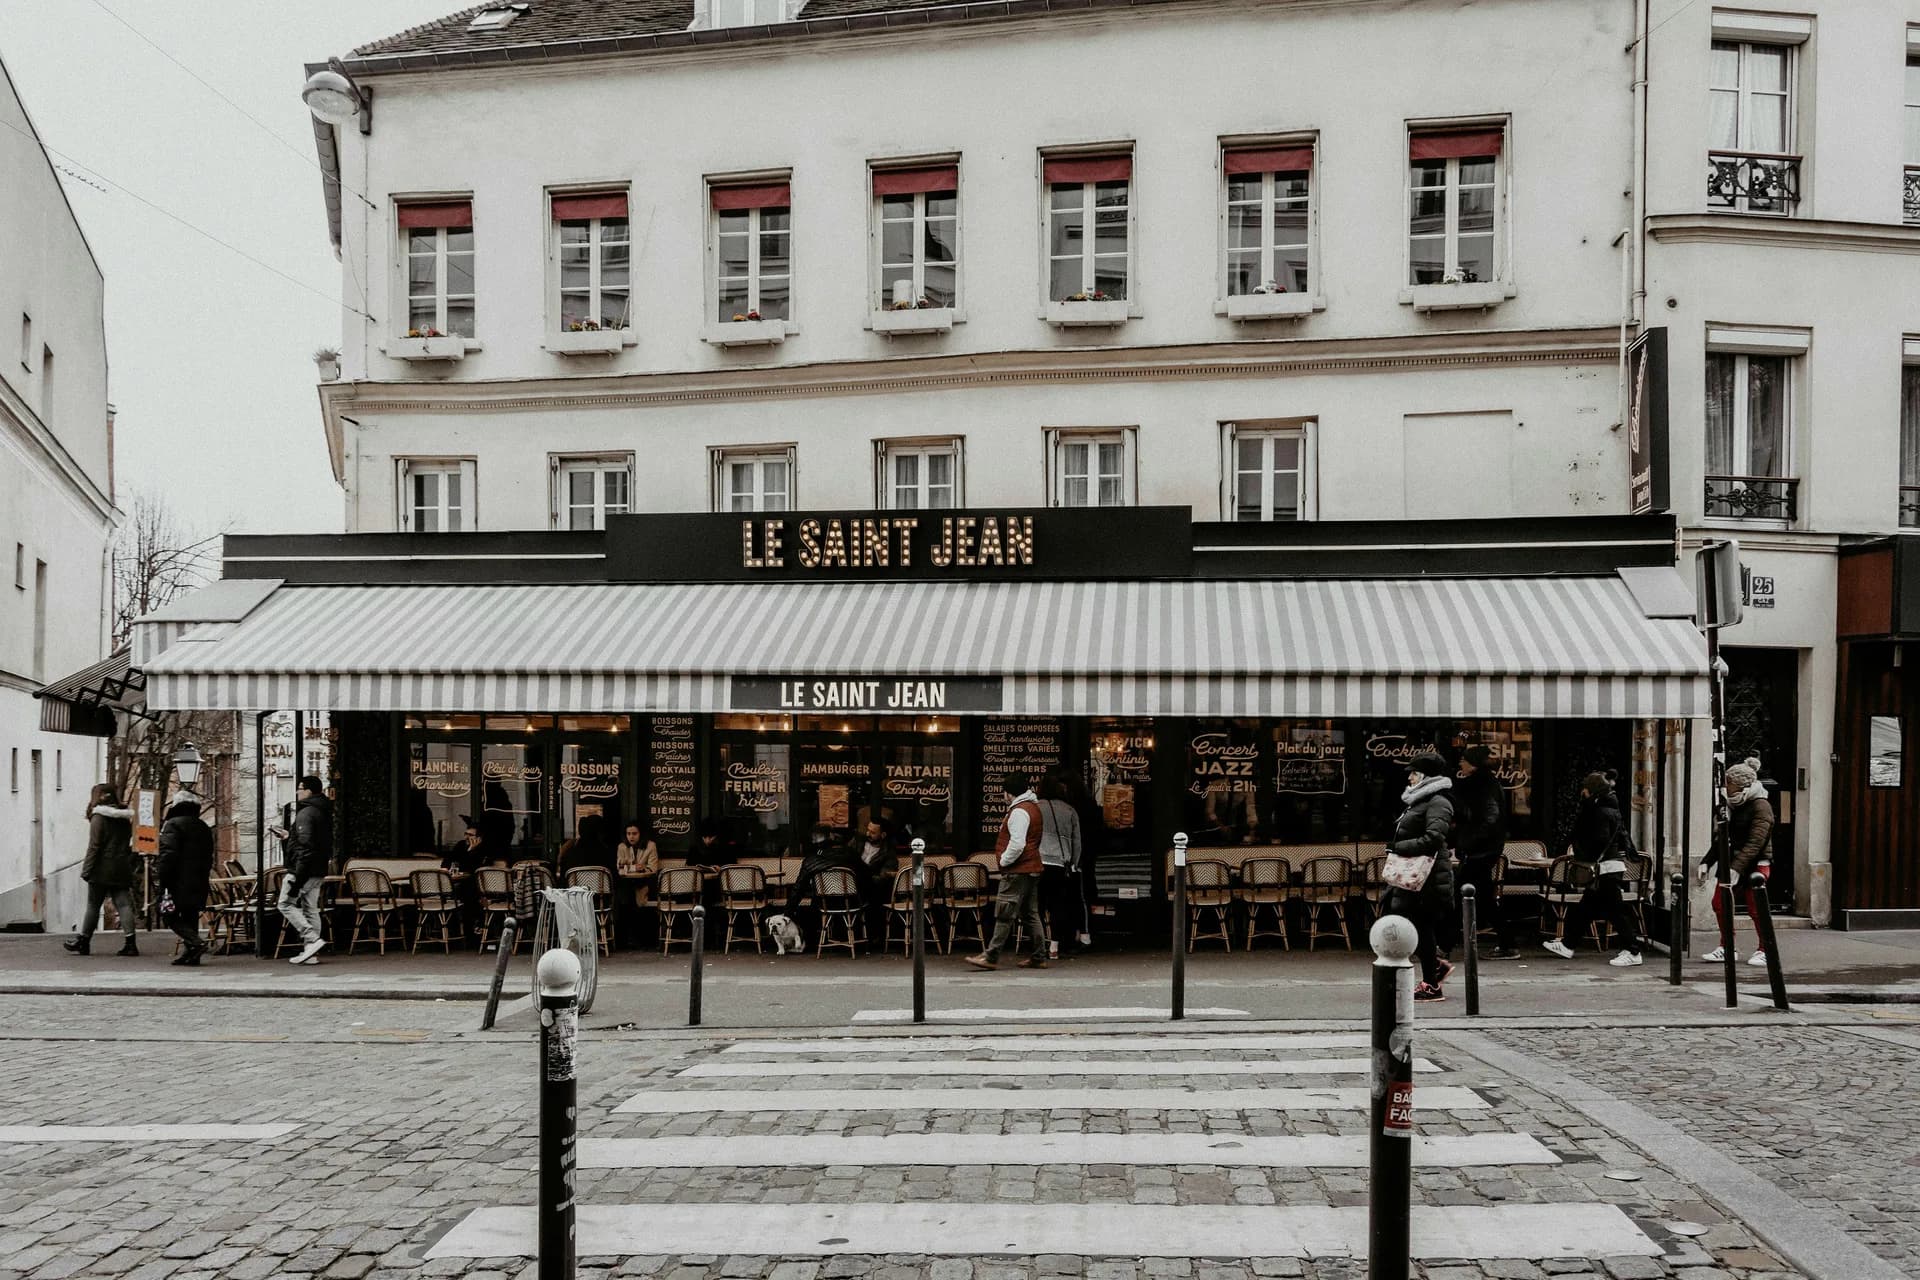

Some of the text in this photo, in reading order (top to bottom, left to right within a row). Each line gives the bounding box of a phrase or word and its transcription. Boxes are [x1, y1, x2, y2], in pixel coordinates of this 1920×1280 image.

[743, 516, 1034, 567] LE SAINT JEAN
[1754, 577, 1773, 594] 25
[781, 681, 946, 708] LE SAINT JEAN
[651, 717, 693, 725] BOISSONS
[983, 724, 1015, 733] SALADES
[651, 741, 695, 750] BOISSONS
[983, 744, 1024, 753] OMELETTES
[1191, 733, 1260, 760] Concert
[1276, 741, 1345, 759] Plat du jour
[1101, 749, 1150, 769] Continu
[412, 761, 460, 774] PLANCHE
[507, 763, 518, 774] du
[518, 763, 543, 780] jour
[560, 763, 620, 775] BOISSONS
[650, 766, 696, 774] COCKTAILS
[727, 762, 782, 781] Poulet
[803, 763, 870, 775] HAMBURGER
[886, 765, 951, 778] TARTARE
[1194, 760, 1254, 776] JAZZ
[413, 774, 472, 798] Charcuterie
[562, 776, 619, 799] Chaudes
[724, 780, 786, 793] FERMIER
[886, 779, 951, 805] Charolais
[1188, 780, 1203, 795] Le
[1233, 780, 1257, 792] 21h
